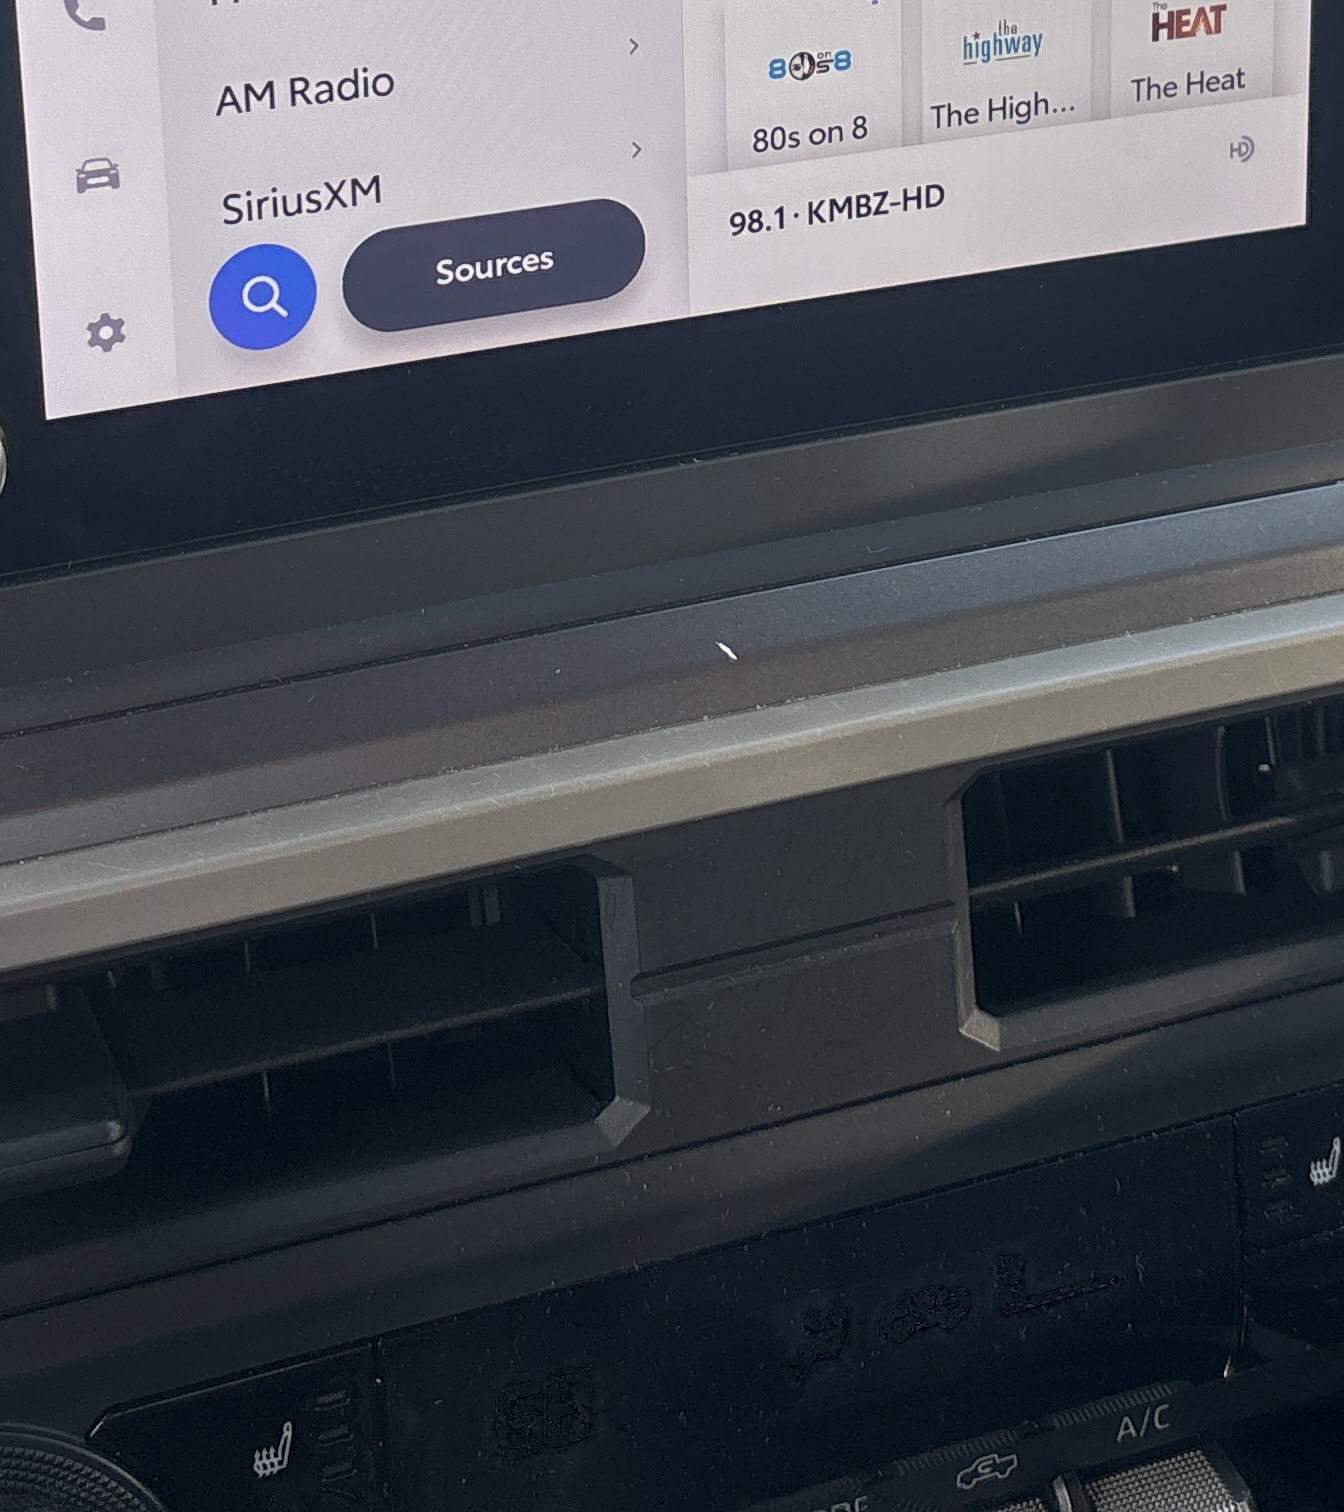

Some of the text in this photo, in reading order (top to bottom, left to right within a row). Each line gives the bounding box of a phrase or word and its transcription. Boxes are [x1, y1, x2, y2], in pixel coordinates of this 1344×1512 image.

[997, 17, 1019, 37] the
[1151, 3, 1227, 42] HEAT
[962, 32, 1043, 64] highway
[215, 66, 395, 117] AM Radio
[1130, 67, 1246, 103] The Heat
[752, 115, 868, 153] 80s on 8
[930, 102, 980, 129] The
[222, 174, 381, 225] SiriusXM
[807, 183, 945, 226] KMBZ-HD
[436, 251, 554, 285] Sources
[1116, 1404, 1170, 1442] A/C
